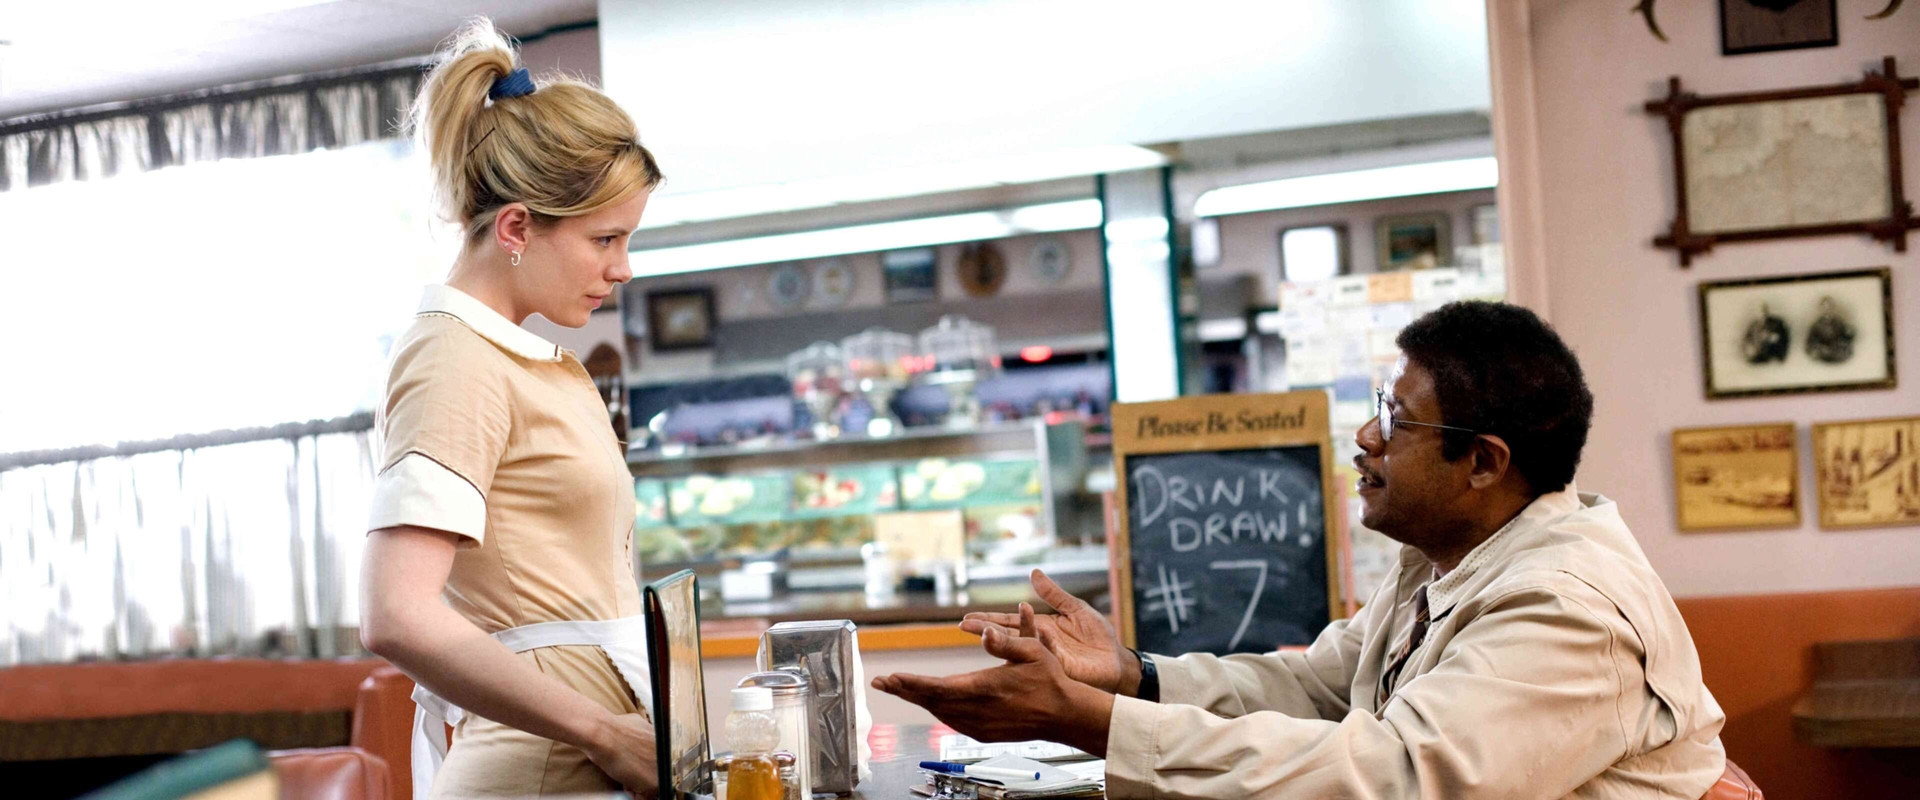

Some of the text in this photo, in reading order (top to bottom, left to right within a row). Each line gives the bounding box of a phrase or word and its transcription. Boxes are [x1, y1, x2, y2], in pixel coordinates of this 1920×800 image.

[1137, 405, 1306, 439] Please Be Seated
[1168, 502, 1313, 551] DRAW!
